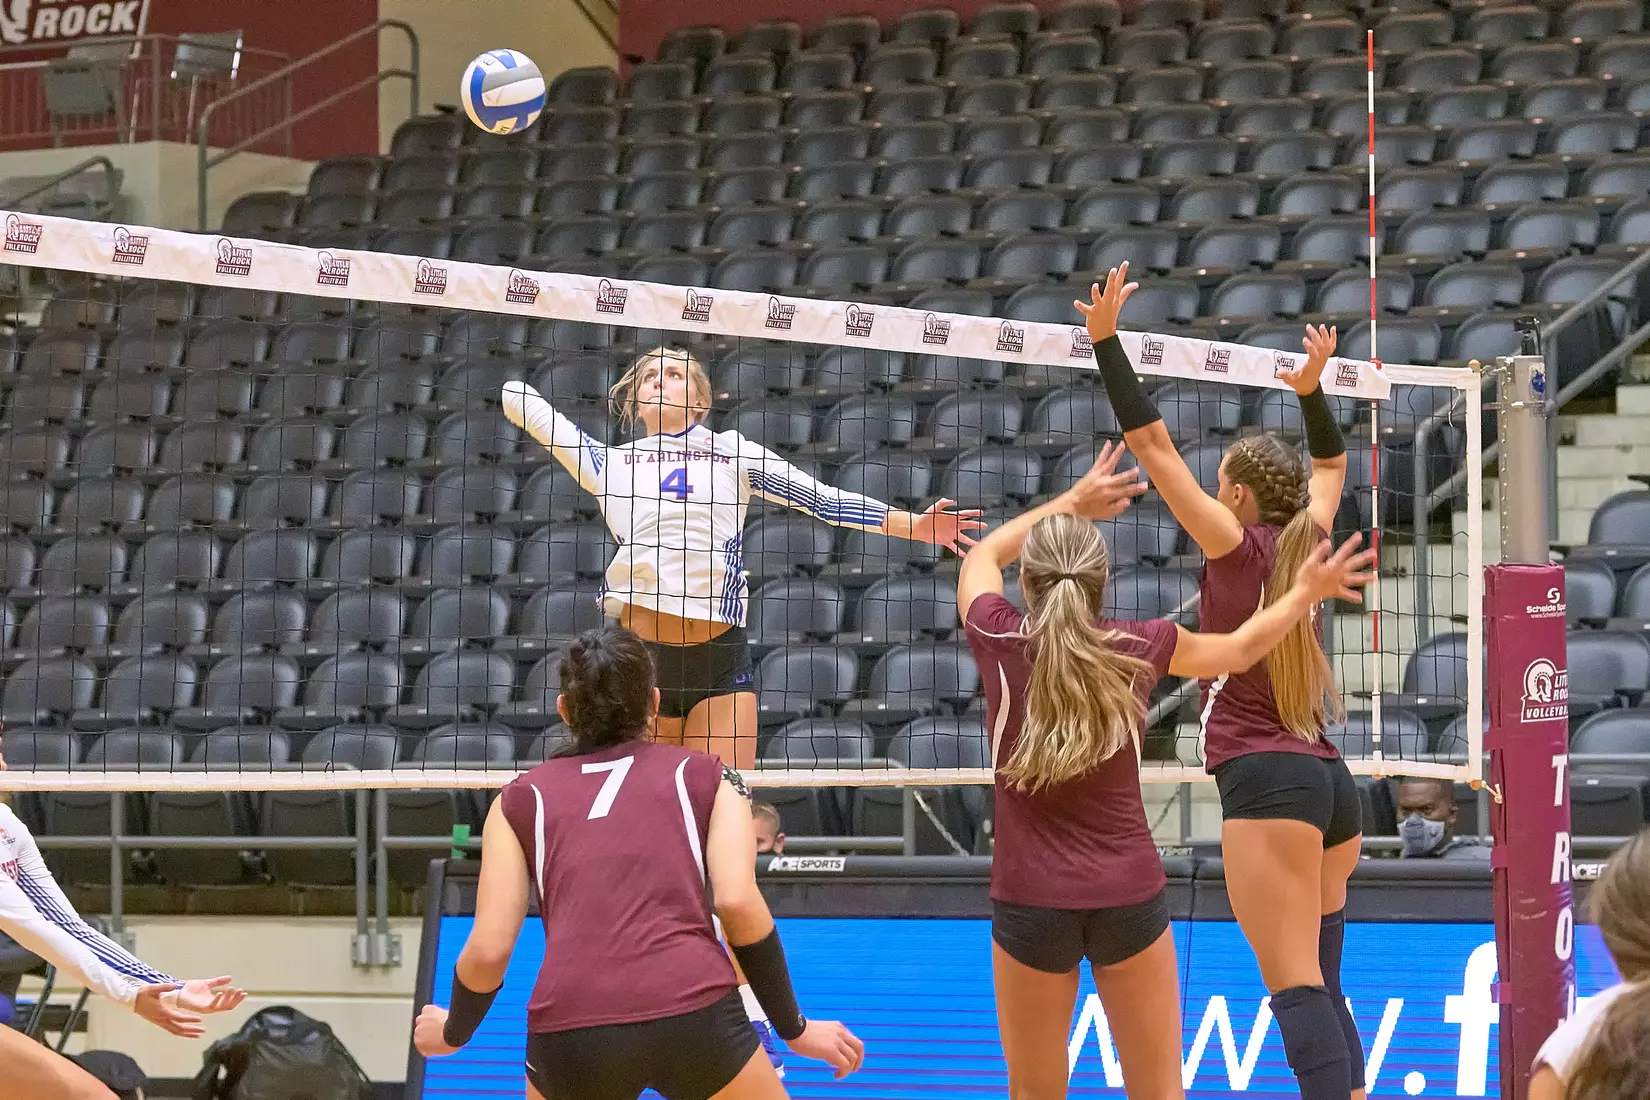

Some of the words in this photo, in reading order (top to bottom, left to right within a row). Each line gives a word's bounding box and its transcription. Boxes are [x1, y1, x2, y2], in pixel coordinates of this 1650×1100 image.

[32, 0, 140, 39] ROCK
[19, 234, 39, 242] ROCK
[129, 245, 146, 253] ROCK
[231, 256, 250, 265] ROCK
[218, 266, 248, 274] VOLLEYBALL
[319, 276, 347, 285] VOLLEYBALL
[429, 276, 446, 285] ROCK
[520, 286, 539, 294] ROCK
[624, 454, 643, 464] UT
[646, 451, 730, 464] ARLINGTON
[660, 468, 693, 500] 4
[1526, 604, 1556, 613] Schelde
[582, 756, 634, 820] 7
[800, 860, 841, 868] SPORTS
